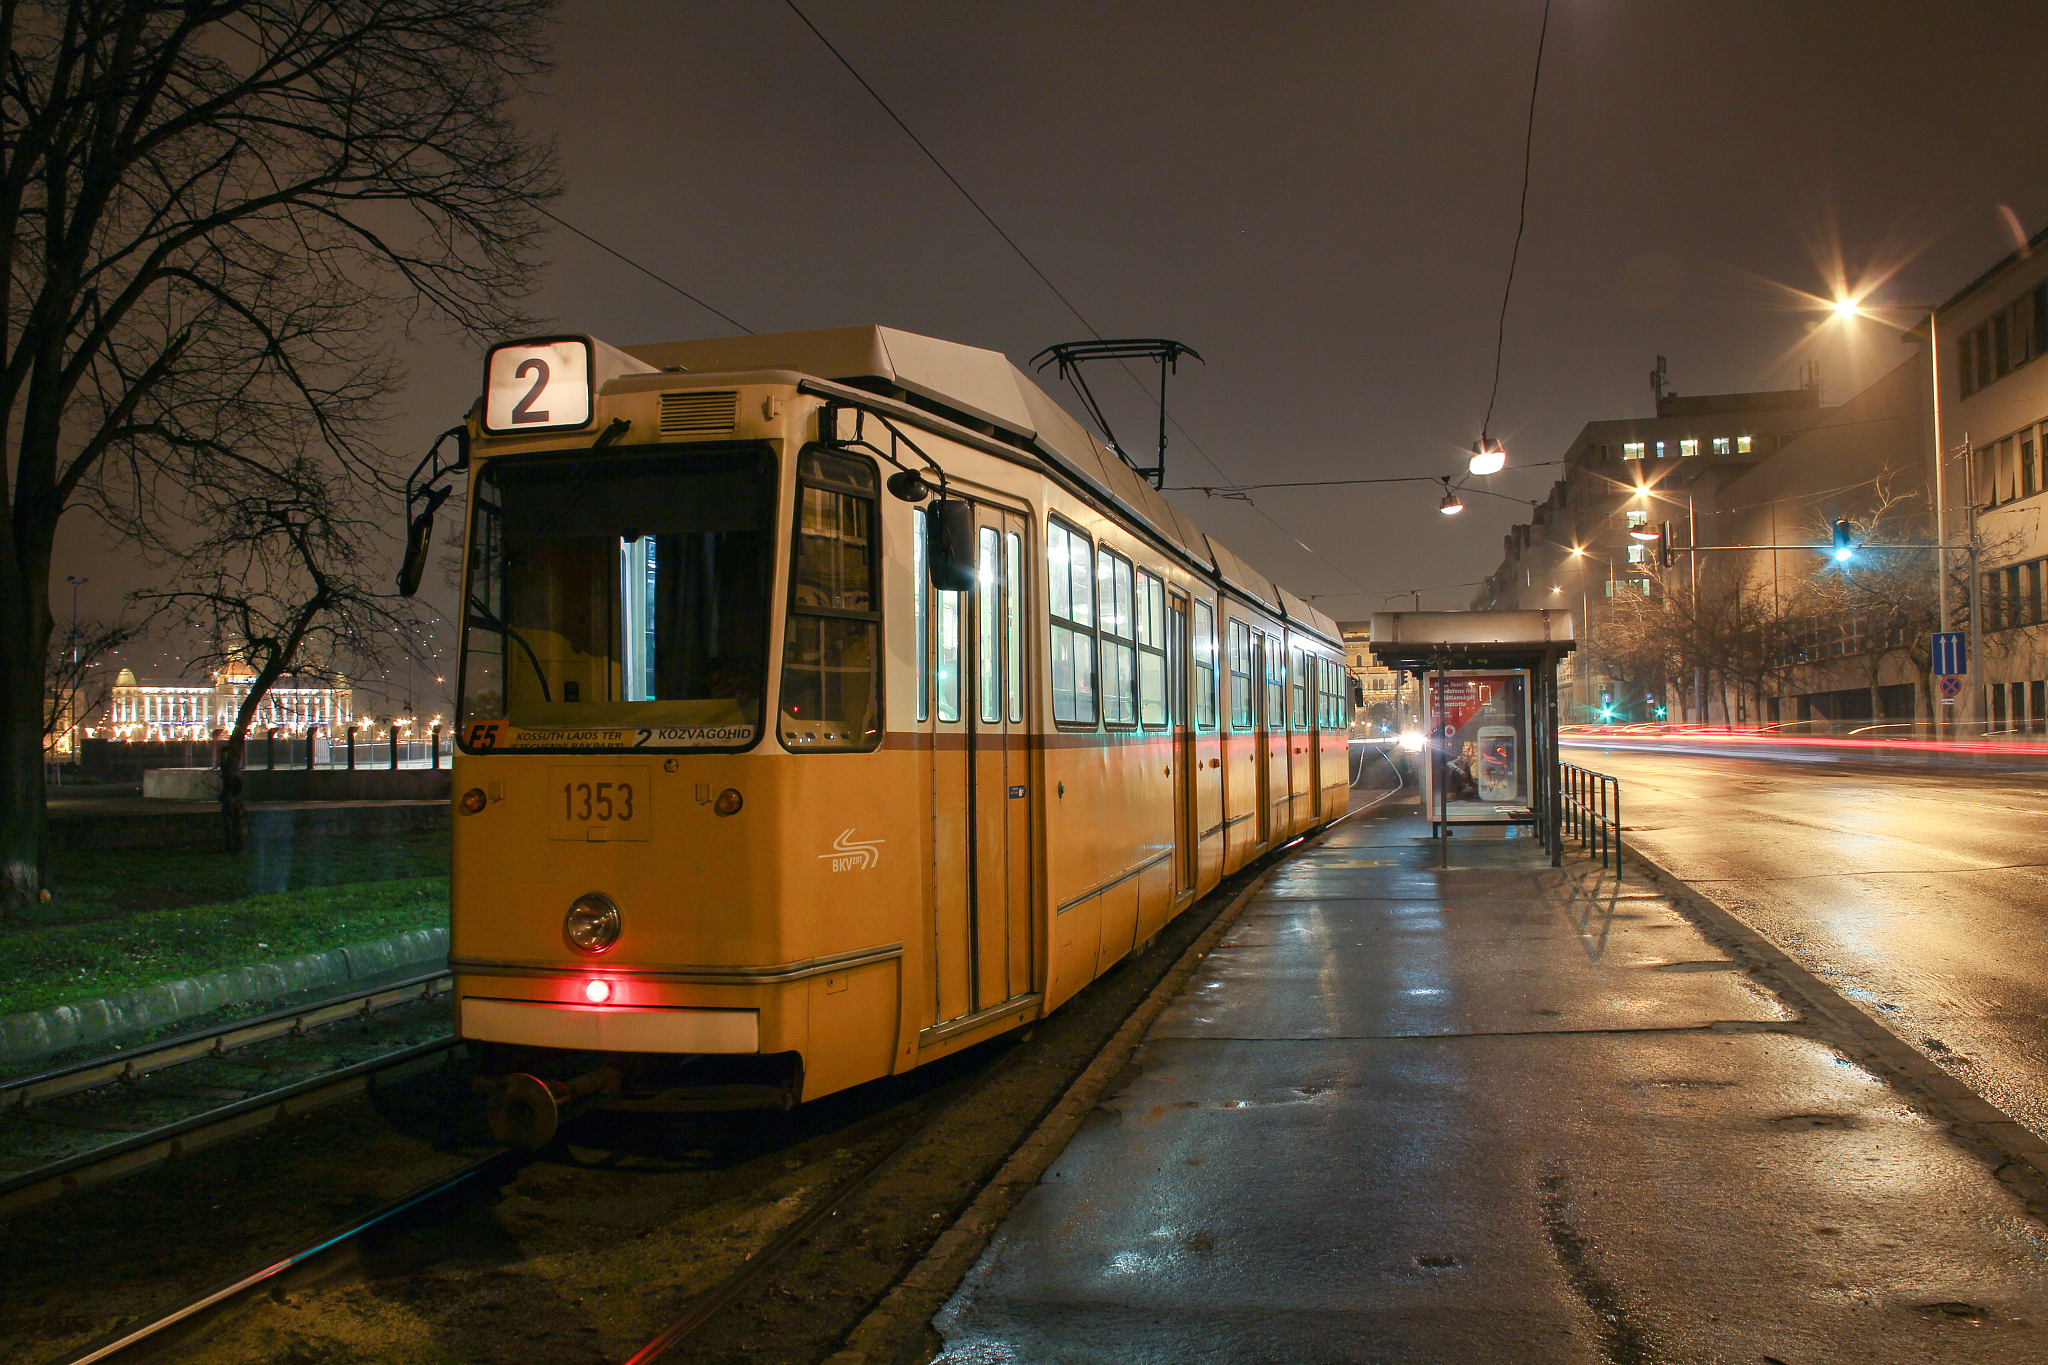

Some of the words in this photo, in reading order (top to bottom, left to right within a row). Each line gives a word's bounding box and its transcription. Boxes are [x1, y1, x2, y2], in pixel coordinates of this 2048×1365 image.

[512, 358, 550, 424] 2
[516, 732, 564, 741] KOSSUTH
[566, 731, 598, 740] LAJOS
[602, 730, 622, 740] TÉR
[634, 728, 652, 747] 2
[564, 782, 633, 821] 1353
